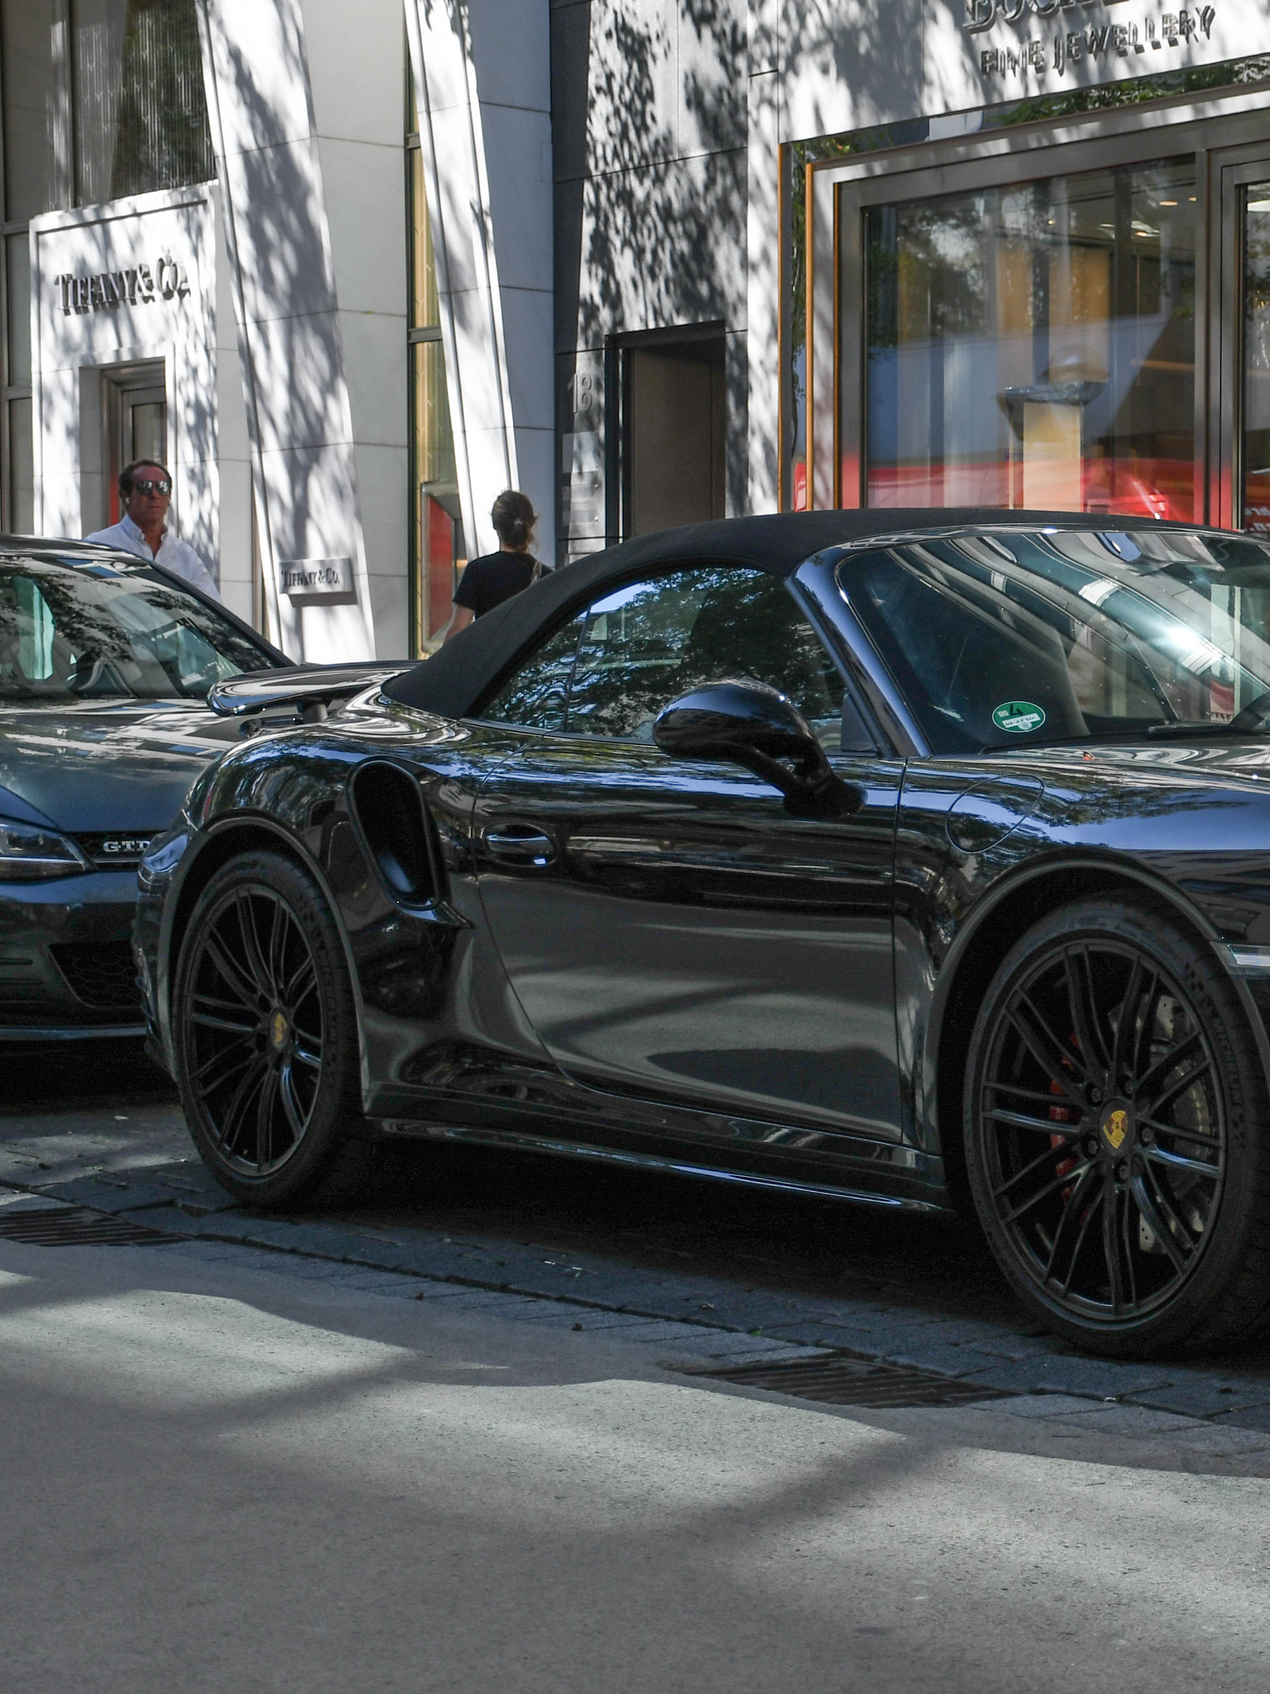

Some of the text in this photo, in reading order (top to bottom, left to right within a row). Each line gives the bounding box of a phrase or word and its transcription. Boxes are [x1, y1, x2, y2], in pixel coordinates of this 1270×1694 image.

[981, 39, 1045, 77] FINE
[1052, 5, 1216, 76] JEWELLERY
[53, 269, 138, 312] TIFFANY
[135, 262, 155, 302] &
[567, 373, 593, 413] 18
